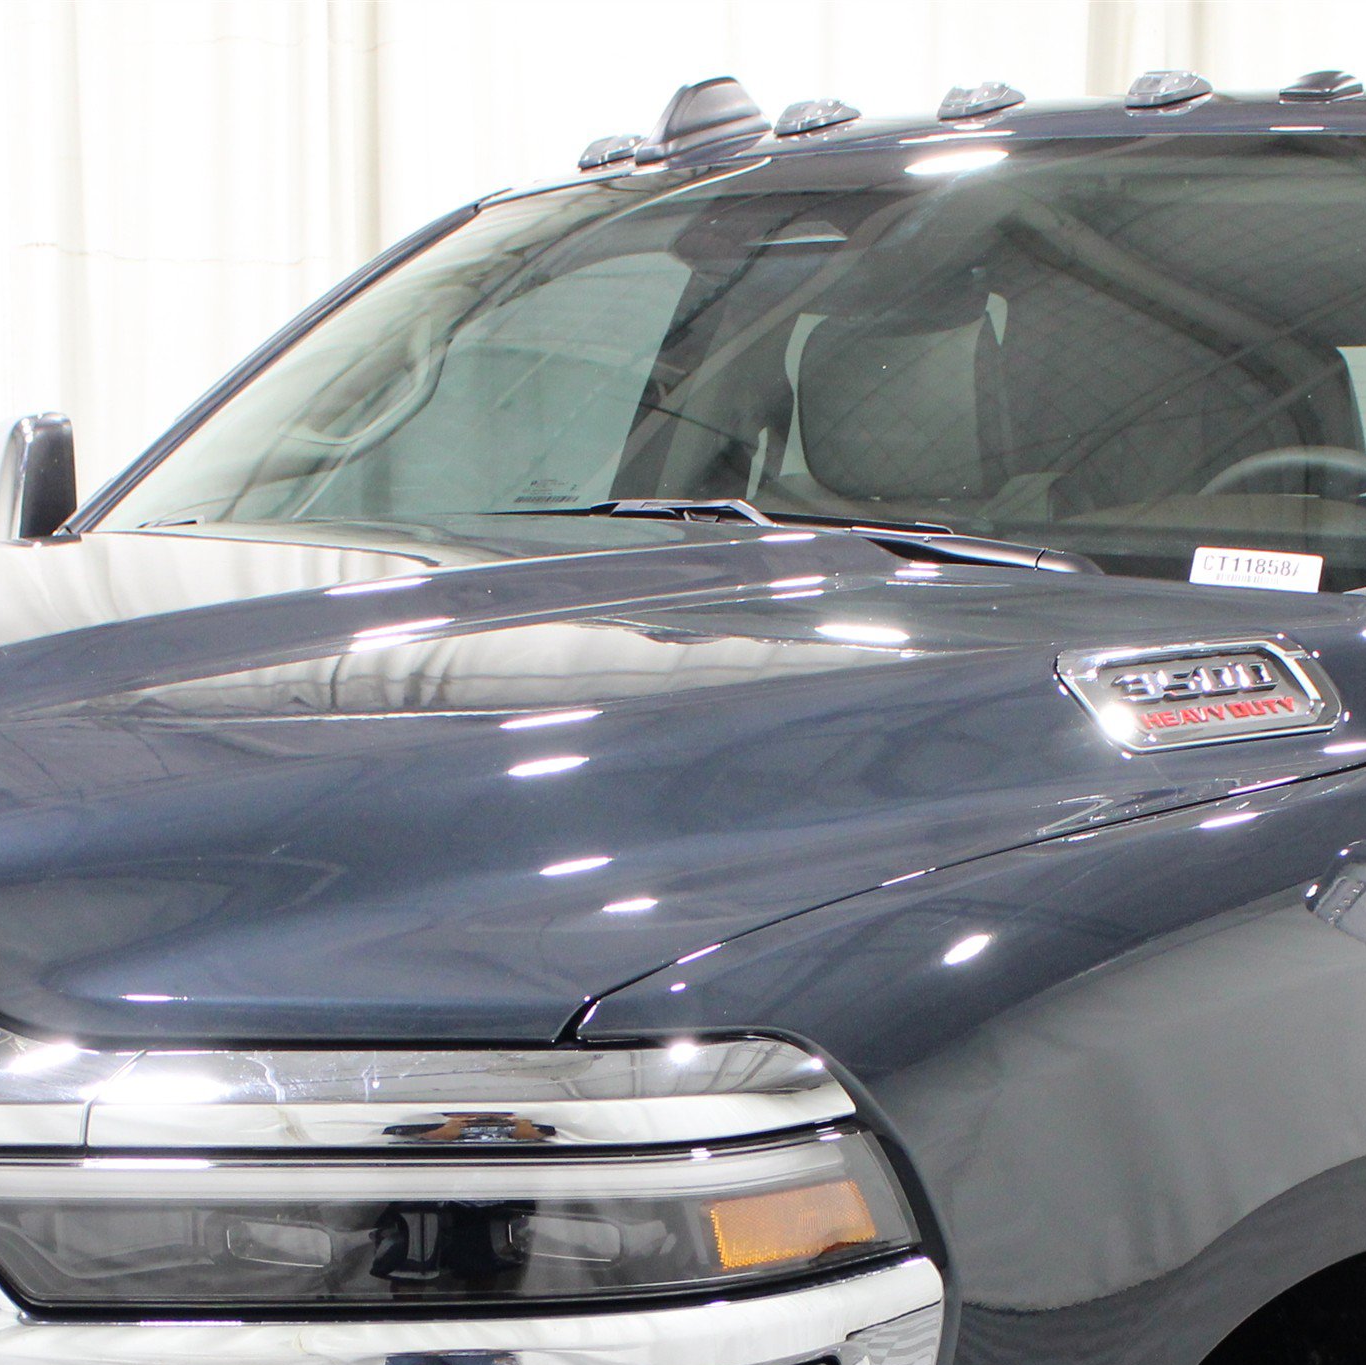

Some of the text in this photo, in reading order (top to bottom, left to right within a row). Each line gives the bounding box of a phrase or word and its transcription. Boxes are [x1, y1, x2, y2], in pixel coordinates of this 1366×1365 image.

[1111, 661, 1279, 701] 3500
[1140, 696, 1295, 730] HEAVY DUTY
